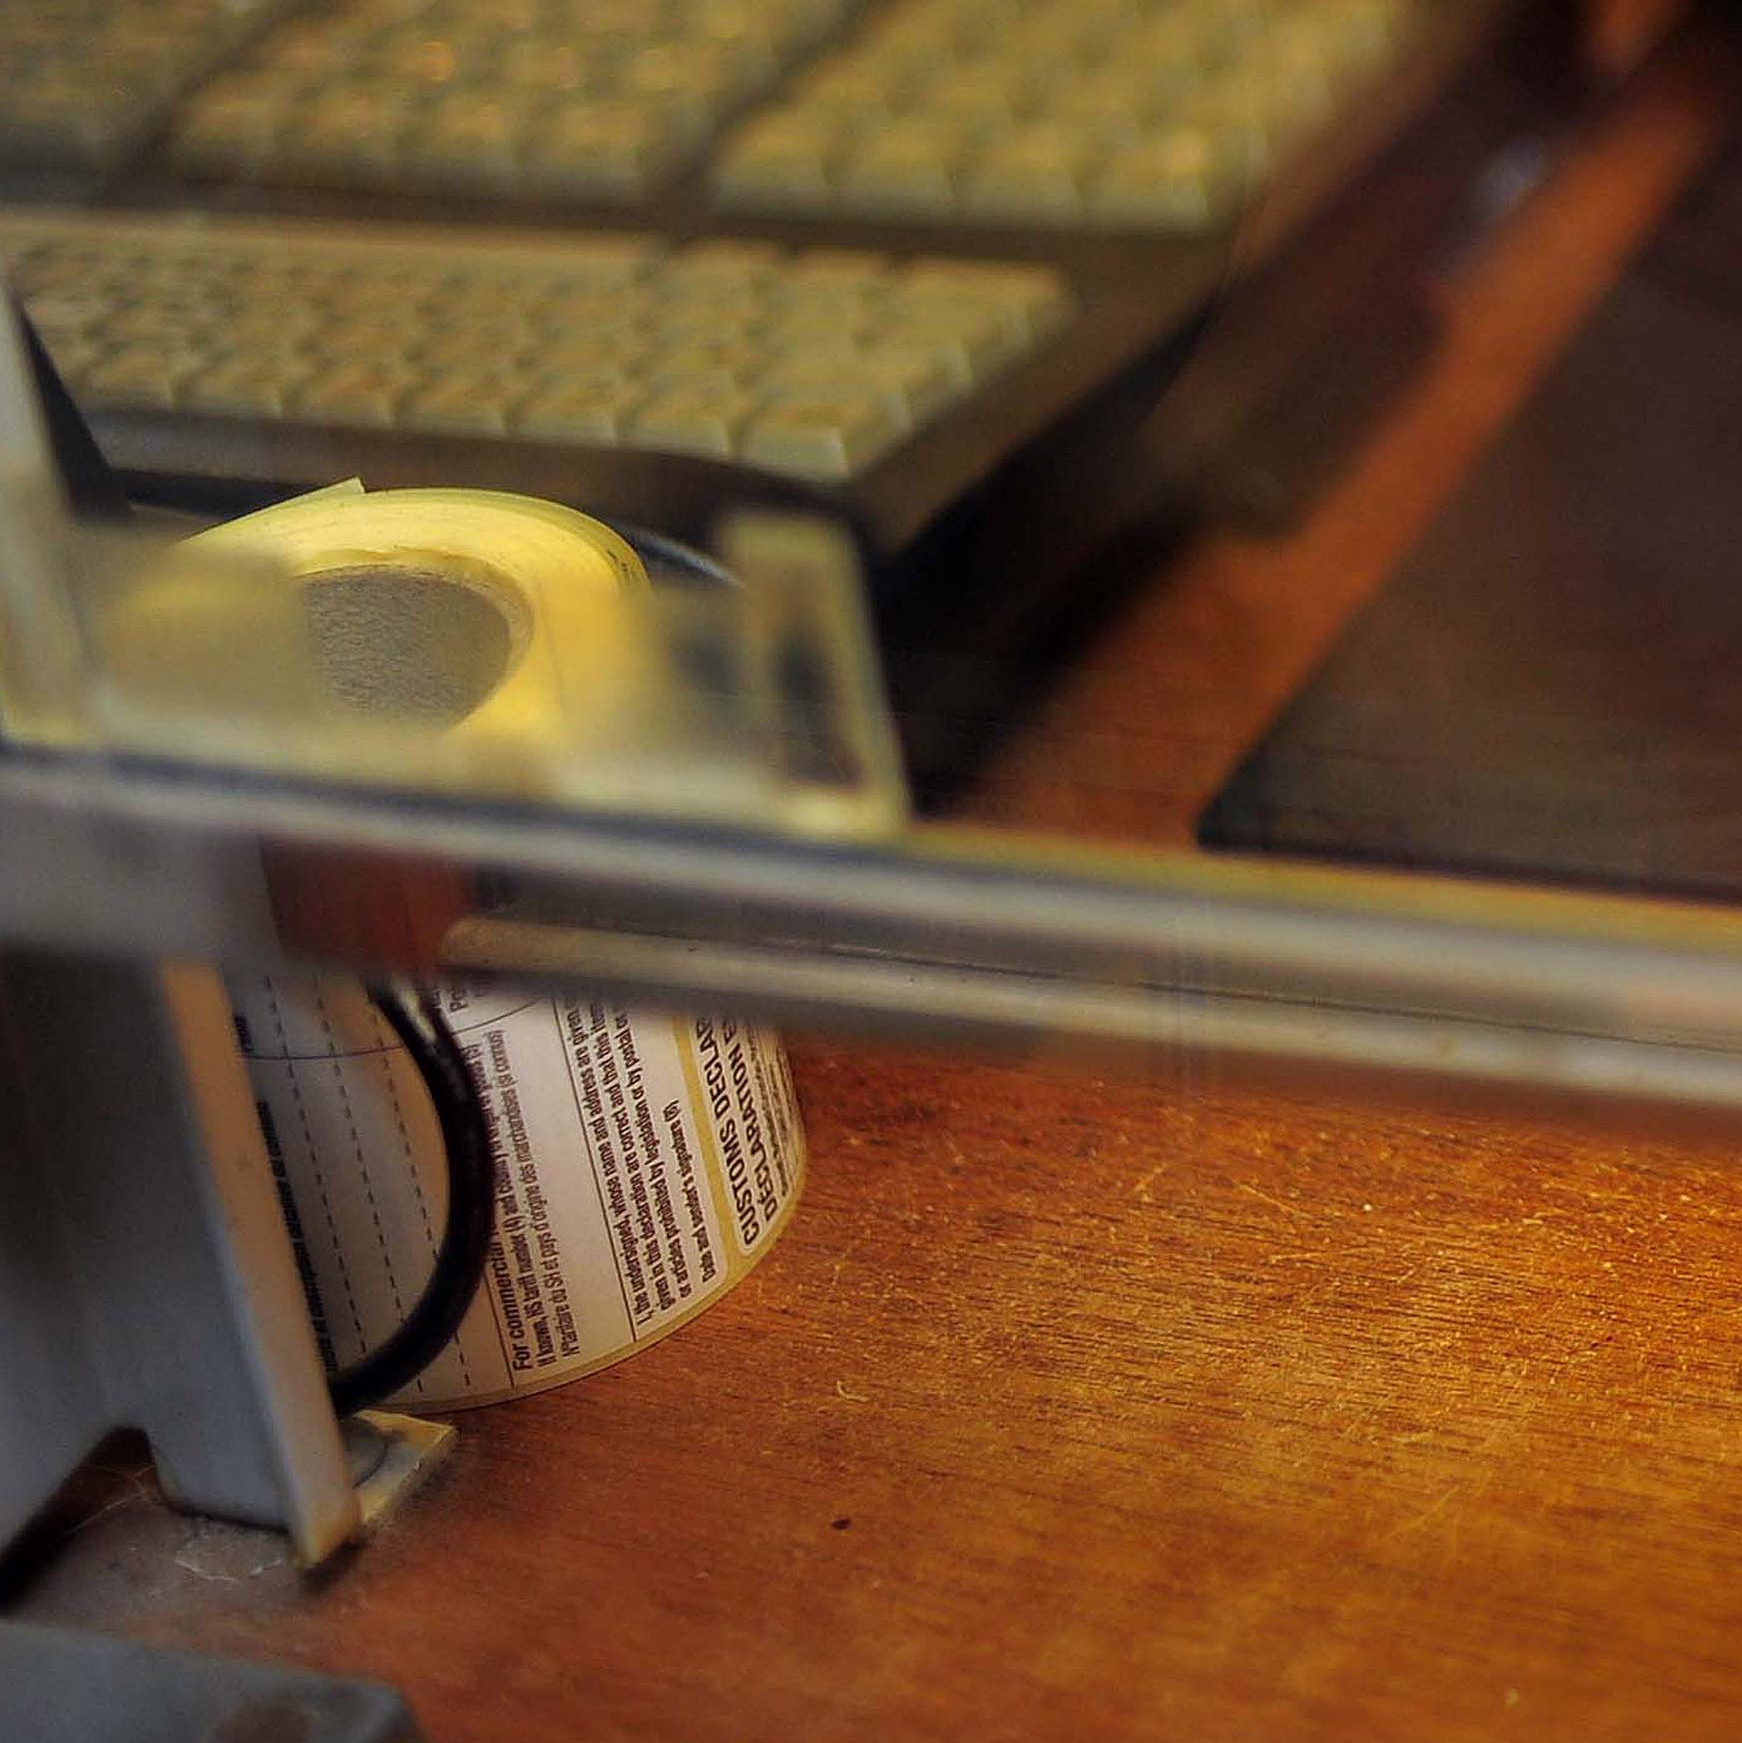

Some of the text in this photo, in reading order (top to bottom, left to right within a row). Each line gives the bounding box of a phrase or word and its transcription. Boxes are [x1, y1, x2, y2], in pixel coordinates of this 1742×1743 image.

[566, 1009, 588, 1044] given
[575, 1045, 591, 1068] are
[593, 1031, 612, 1059] this
[615, 1029, 639, 1068] postal
[598, 1055, 618, 1085] that
[626, 1067, 642, 1088] by
[580, 1067, 602, 1115] address
[604, 1082, 624, 1107] and
[631, 1084, 645, 1099] or
[588, 1116, 608, 1140] and
[611, 1107, 635, 1151] correct
[635, 1100, 660, 1164] legislation
[695, 1016, 759, 1243] CUSTOMS DECLAR
[729, 1045, 777, 1218] DÉCLARATION
[598, 1141, 616, 1177] name
[670, 1121, 693, 1175] signature
[518, 1163, 538, 1185] des
[624, 1151, 640, 1174] are
[648, 1161, 664, 1182] by
[493, 1192, 518, 1218] and
[606, 1176, 626, 1215] whose
[629, 1173, 655, 1239] declaration
[654, 1180, 679, 1238] prohibited
[536, 1231, 560, 1258] pays
[614, 1214, 644, 1288] undersigned,
[642, 1238, 662, 1265] this
[691, 1226, 709, 1250] and
[539, 1257, 560, 1271] et
[649, 1262, 665, 1280] in
[667, 1238, 688, 1282] articles
[547, 1288, 568, 1304] du
[633, 1291, 651, 1314] the
[655, 1276, 676, 1309] given
[511, 1343, 533, 1371] For
